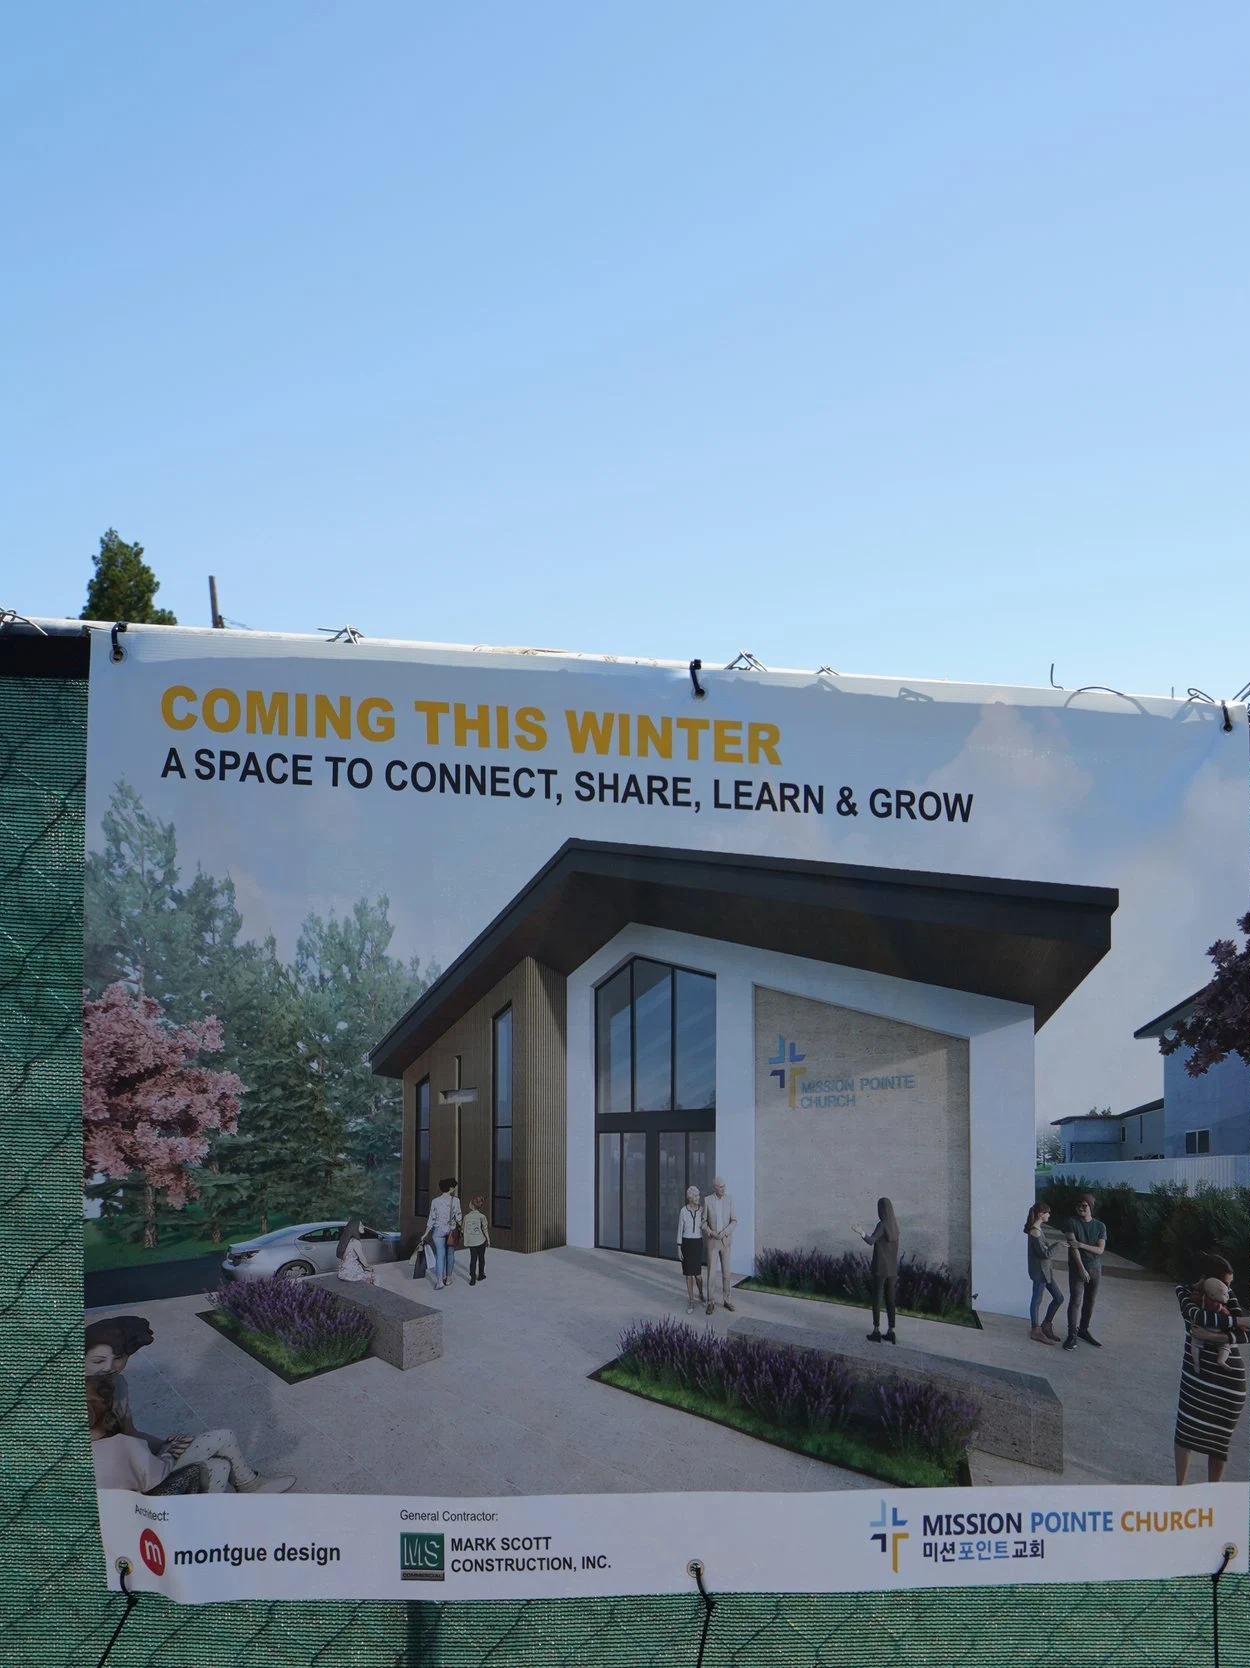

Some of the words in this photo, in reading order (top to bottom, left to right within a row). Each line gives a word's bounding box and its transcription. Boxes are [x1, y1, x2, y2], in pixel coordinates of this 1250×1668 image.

[160, 685, 395, 742] COMING
[415, 700, 548, 752] THIS
[565, 709, 781, 766] WINTER
[161, 747, 186, 779] A
[195, 748, 312, 786] SPACE
[325, 756, 373, 789] TO
[384, 760, 562, 806] CONNECT,
[575, 770, 701, 813] SHARE,
[713, 779, 824, 814] LEARN
[836, 786, 859, 816] &
[870, 789, 974, 823] GROW
[801, 1079, 854, 1093] MISSION
[860, 1075, 916, 1090] POINTE
[801, 1095, 856, 1109] CHURCH
[134, 1504, 169, 1521] Architect:
[400, 1509, 439, 1521] General
[442, 1510, 498, 1521] Contractor:
[923, 1512, 1022, 1537] MISSION
[1031, 1511, 1113, 1534] POINTE
[1121, 1507, 1213, 1532] CHURCH
[404, 1537, 440, 1567] MS
[451, 1538, 496, 1551] MARK
[500, 1536, 552, 1551] SCOTT
[174, 1543, 267, 1566] montgue
[273, 1542, 341, 1566] design
[451, 1556, 577, 1572] CONSTRUCTION,
[582, 1555, 611, 1570] INC.
